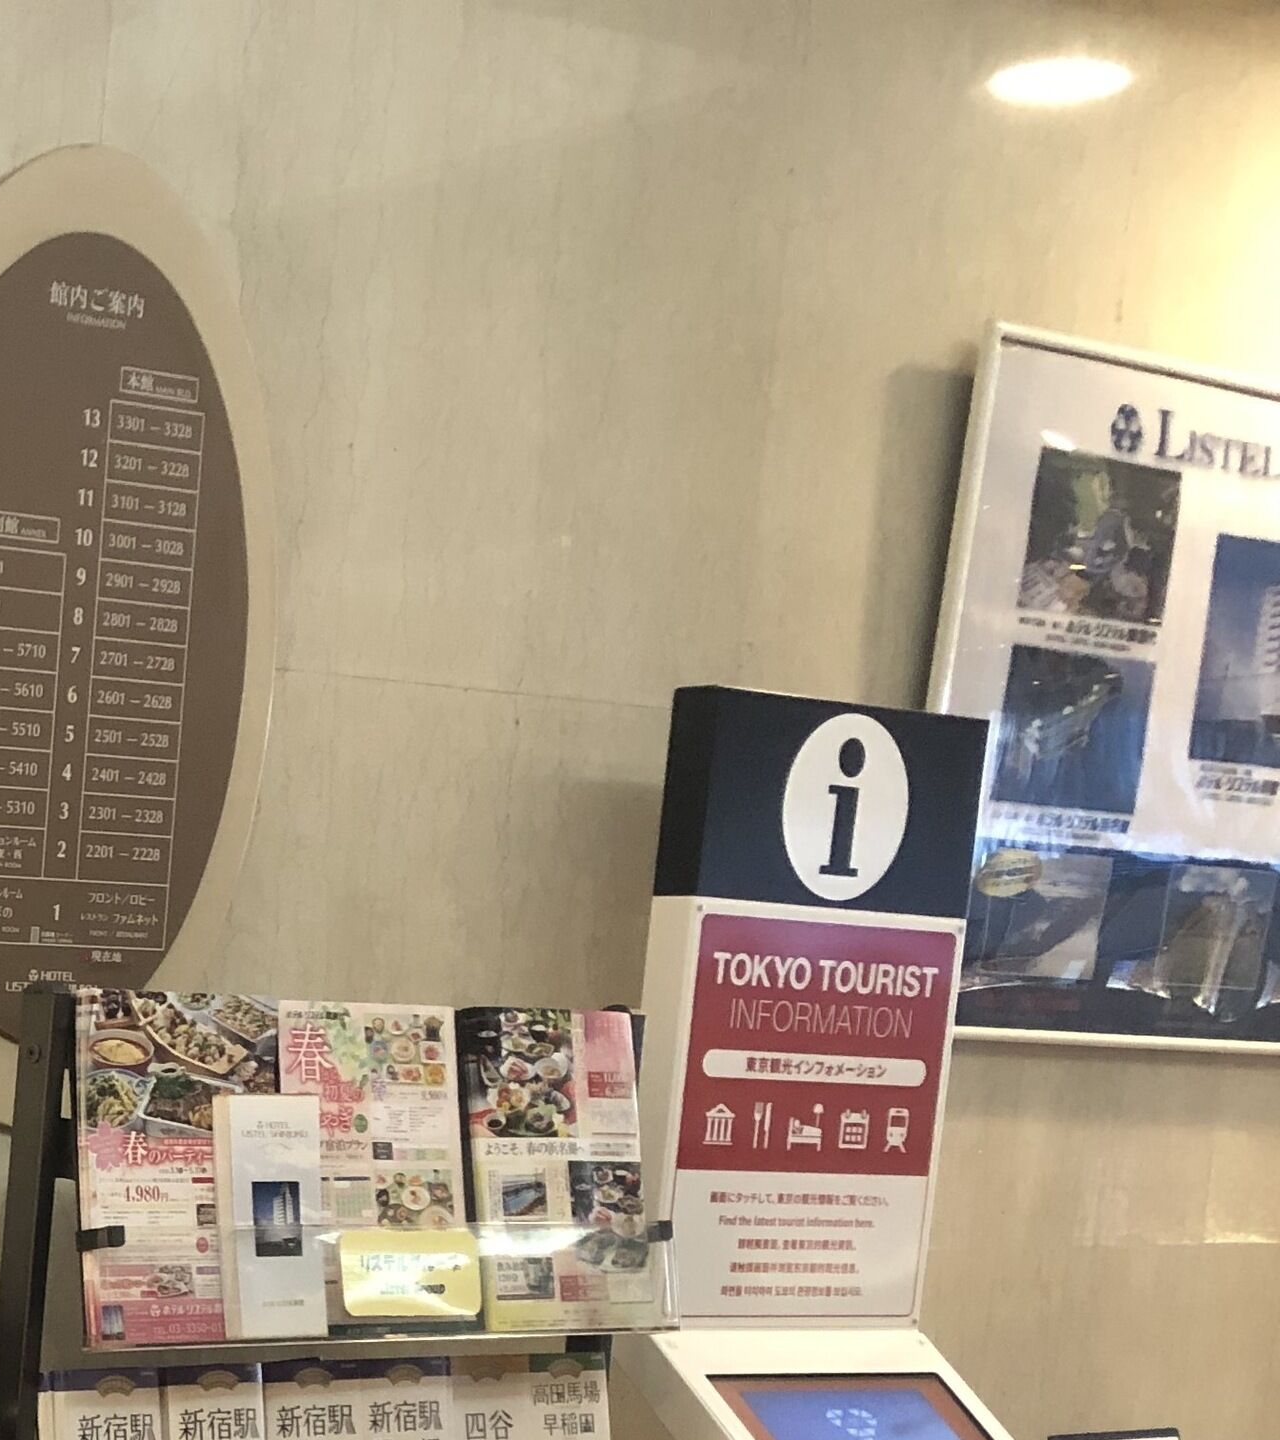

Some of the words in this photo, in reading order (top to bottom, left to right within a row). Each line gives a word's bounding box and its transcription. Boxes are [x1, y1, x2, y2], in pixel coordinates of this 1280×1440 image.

[49, 280, 146, 318] 館内ご案内
[127, 372, 154, 393] 本館
[83, 408, 101, 428] 13
[117, 415, 146, 434] 3301
[164, 421, 193, 439] 3328
[80, 448, 98, 468] 12
[114, 454, 143, 471] 3201
[160, 460, 190, 478] 3228
[78, 488, 94, 507] 11
[112, 494, 140, 511] 3101
[158, 500, 187, 517] 3128
[75, 528, 93, 546] 10
[109, 533, 137, 551] 3001
[155, 539, 184, 557] 3028
[75, 567, 86, 586] 9
[106, 573, 134, 590] 2901
[152, 578, 181, 595] 2928
[73, 607, 83, 626] 8
[103, 612, 131, 629] 2801
[150, 616, 179, 634] 2828
[17, 642, 46, 659] 5710
[70, 646, 80, 664] 7
[100, 651, 128, 668] 2701
[146, 655, 175, 673] 2728
[14, 682, 44, 699] 5610
[67, 686, 77, 704] 6
[97, 690, 125, 706] 2601
[143, 694, 172, 711] 2628
[11, 721, 41, 738] 5510
[64, 725, 75, 743] 5
[94, 728, 123, 745] 2501
[141, 732, 170, 749] 2528
[8, 760, 38, 777] 5410
[61, 763, 72, 782] 4
[91, 767, 120, 783] 2401
[137, 770, 167, 787] 2428
[6, 800, 35, 816] 5310
[59, 802, 70, 820] 3
[88, 806, 117, 821] 2301
[135, 808, 164, 825] 2328
[56, 840, 67, 858] 2
[86, 844, 114, 859] 2201
[132, 847, 161, 862] 2228
[52, 904, 61, 921] 1
[40, 970, 76, 982] HOTEL
[713, 951, 811, 991] TOKYO
[818, 958, 939, 998] TOURIST
[729, 997, 913, 1039] INFORMATION
[745, 1056, 887, 1079] 東京観光インフォメーション
[532, 1380, 601, 1406] 高田馬場
[276, 1403, 356, 1439] 新宿駅
[369, 1399, 443, 1433] 新宿駅
[465, 1409, 514, 1440] 四谷
[543, 1412, 595, 1436] 早稲田
